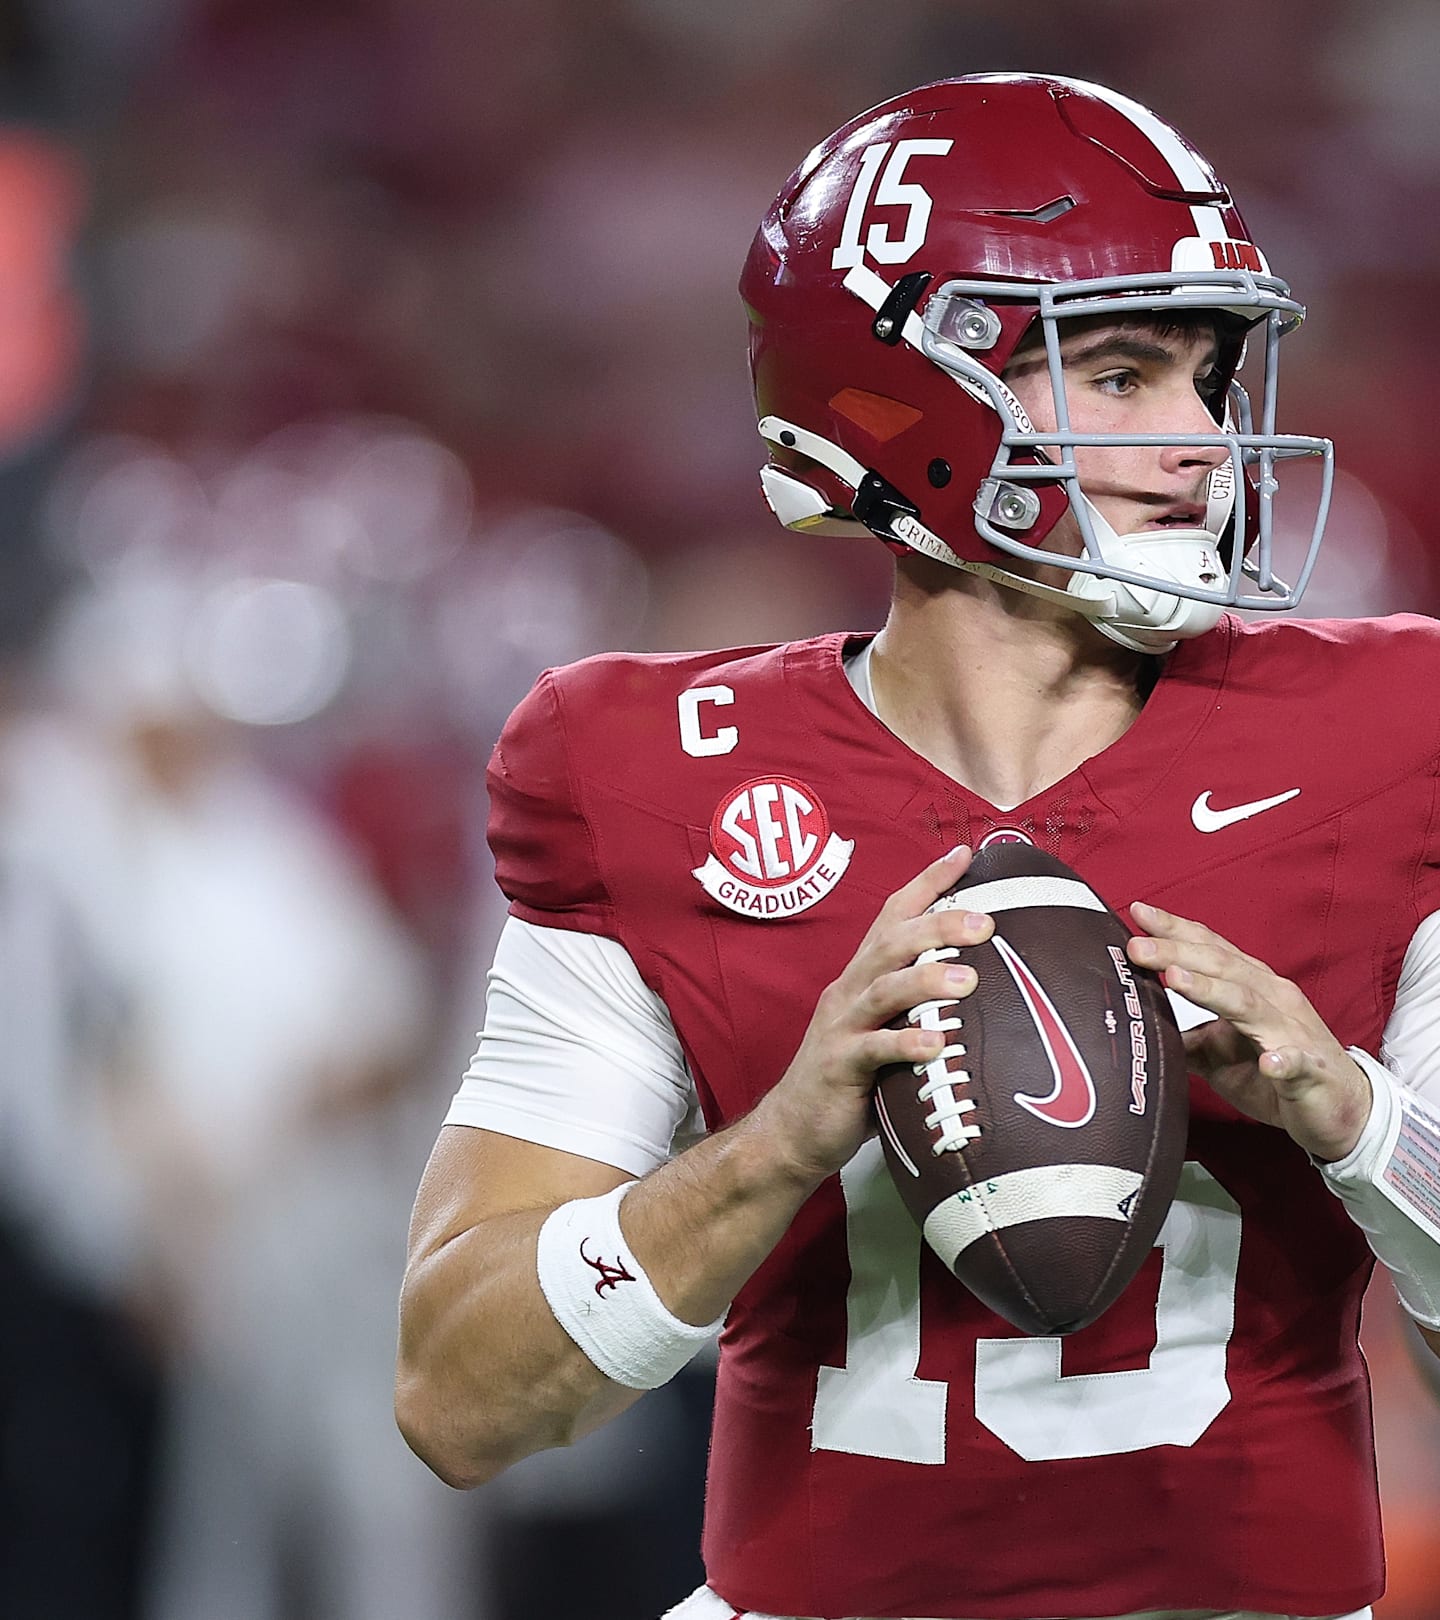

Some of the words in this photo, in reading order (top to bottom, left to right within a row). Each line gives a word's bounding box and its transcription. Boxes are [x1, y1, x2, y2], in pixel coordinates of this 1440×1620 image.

[831, 138, 954, 269] 15
[678, 685, 739, 757] C
[721, 783, 817, 879] SEC
[718, 863, 836, 914] GRADUATE
[1107, 945, 1143, 1019] ELITE
[1129, 1020, 1148, 1115] VAPOR
[811, 988, 1241, 1465] 15
